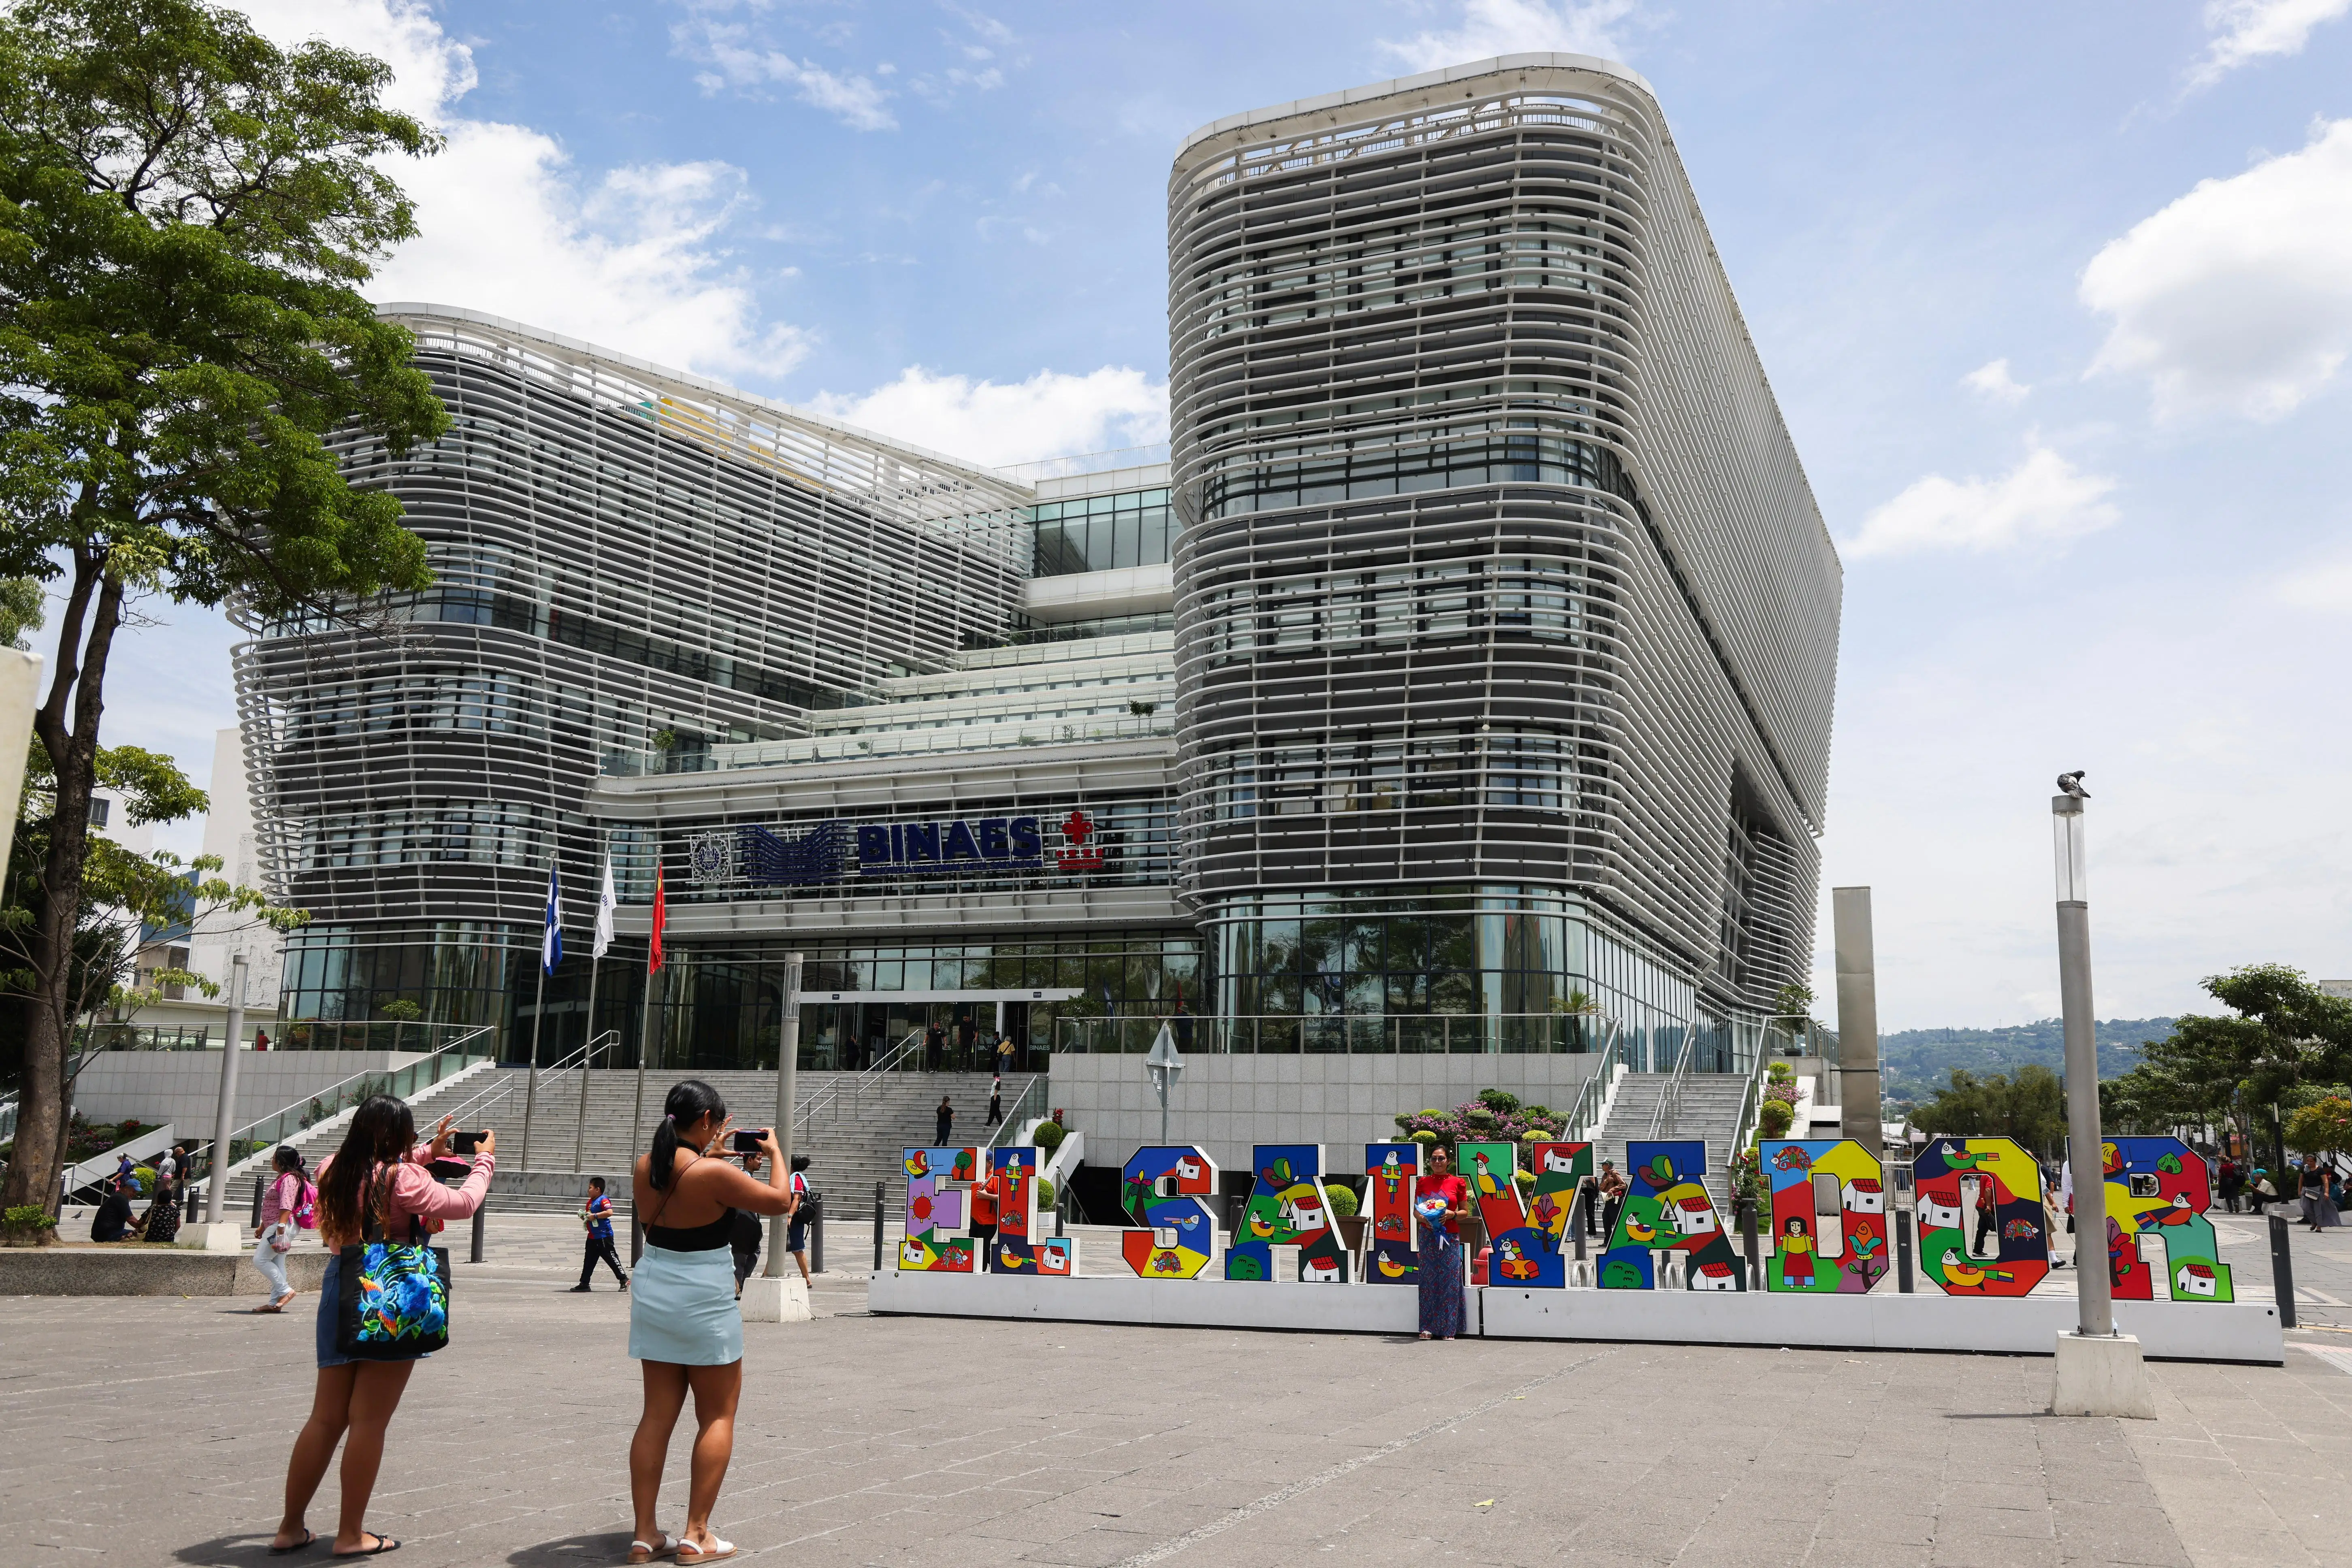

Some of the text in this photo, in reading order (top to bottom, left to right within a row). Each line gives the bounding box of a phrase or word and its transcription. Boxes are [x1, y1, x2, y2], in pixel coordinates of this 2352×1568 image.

[857, 817, 1041, 863] BINAES
[860, 859, 1043, 876] BIBLIOTECA NACIONAL DE EL SALVADOR
[898, 1136, 2235, 1303] EL SALVADOR
